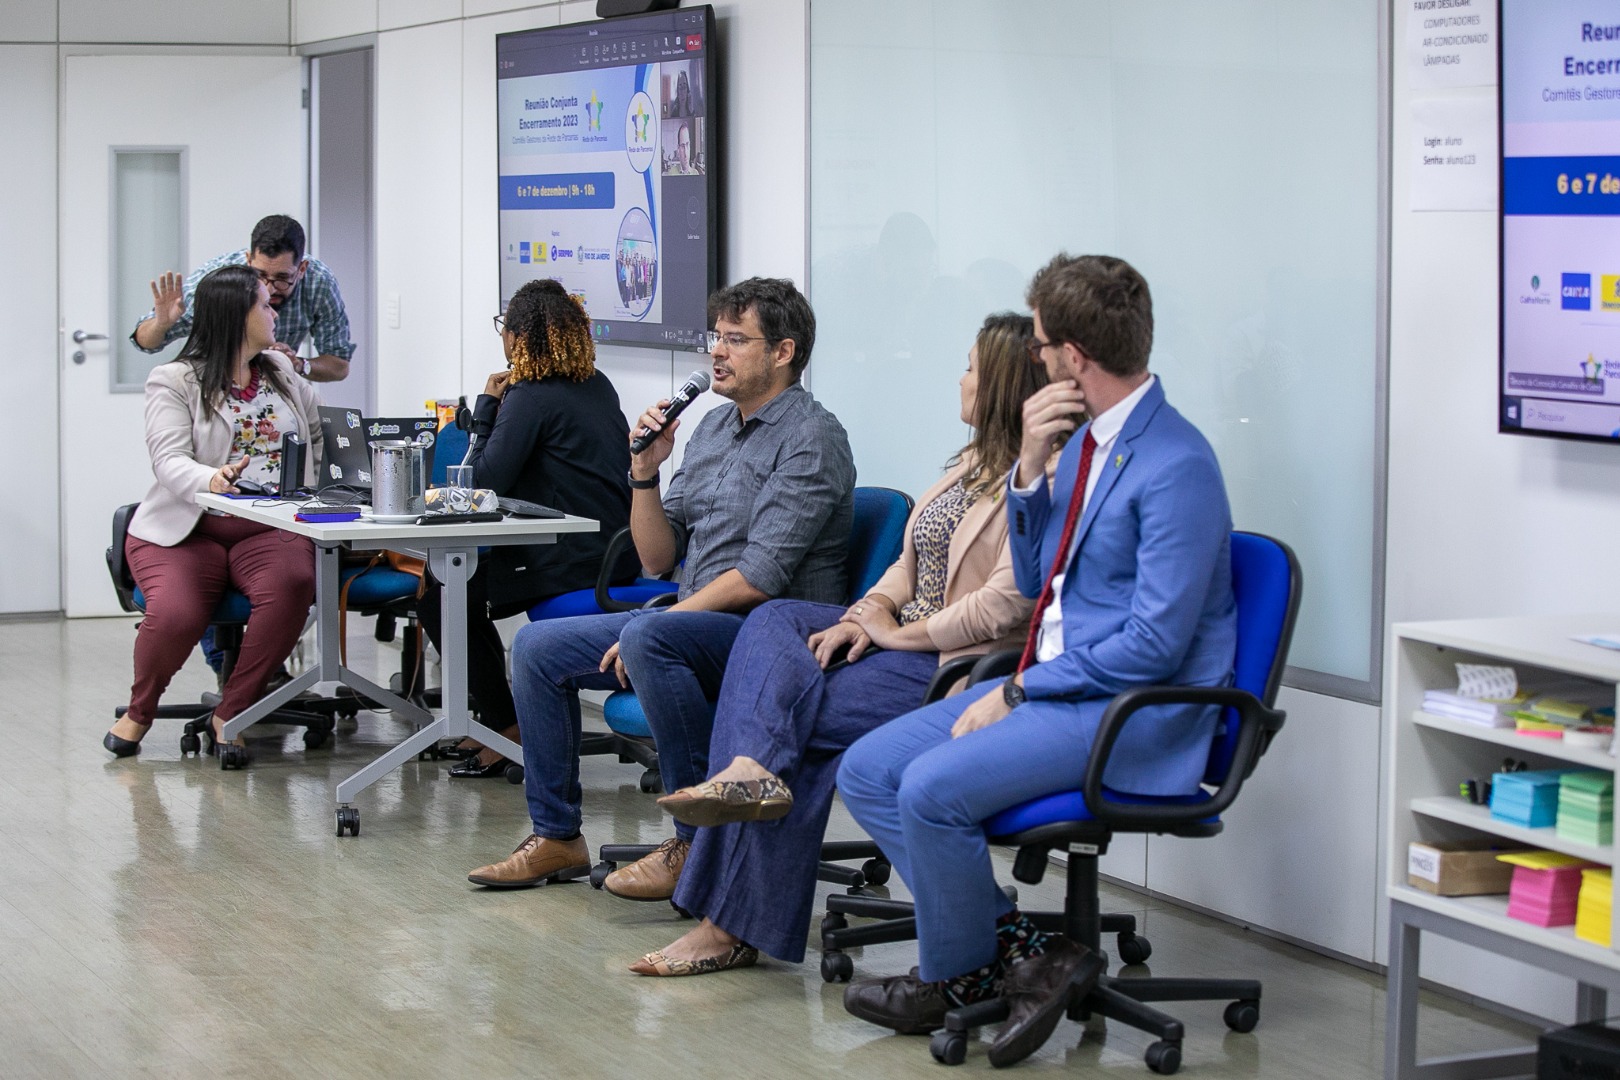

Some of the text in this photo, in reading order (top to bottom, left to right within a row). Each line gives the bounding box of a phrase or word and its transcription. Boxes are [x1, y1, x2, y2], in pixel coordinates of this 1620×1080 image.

[1414, 0, 1436, 11] FAVOR
[1424, 15, 1480, 29] COMPUTADORES
[1423, 33, 1488, 47] AR-CONDICIONADO
[1423, 54, 1460, 66] LÂMPADAS
[1542, 87, 1581, 102] Comitês
[525, 96, 578, 110] Reunião Conjunta
[519, 115, 578, 130] Encerramento 2023
[1424, 136, 1462, 148] Login: aluno
[1424, 154, 1476, 165] Senha: aluno123
[517, 186, 522, 197] 6
[527, 185, 531, 197] 7
[532, 185, 540, 197] de
[540, 185, 568, 197] dezembro
[571, 184, 580, 196] 9h
[584, 183, 596, 196] 18h
[1557, 172, 1620, 194] 6 e 7 de
[1562, 286, 1590, 298] CAIXA
